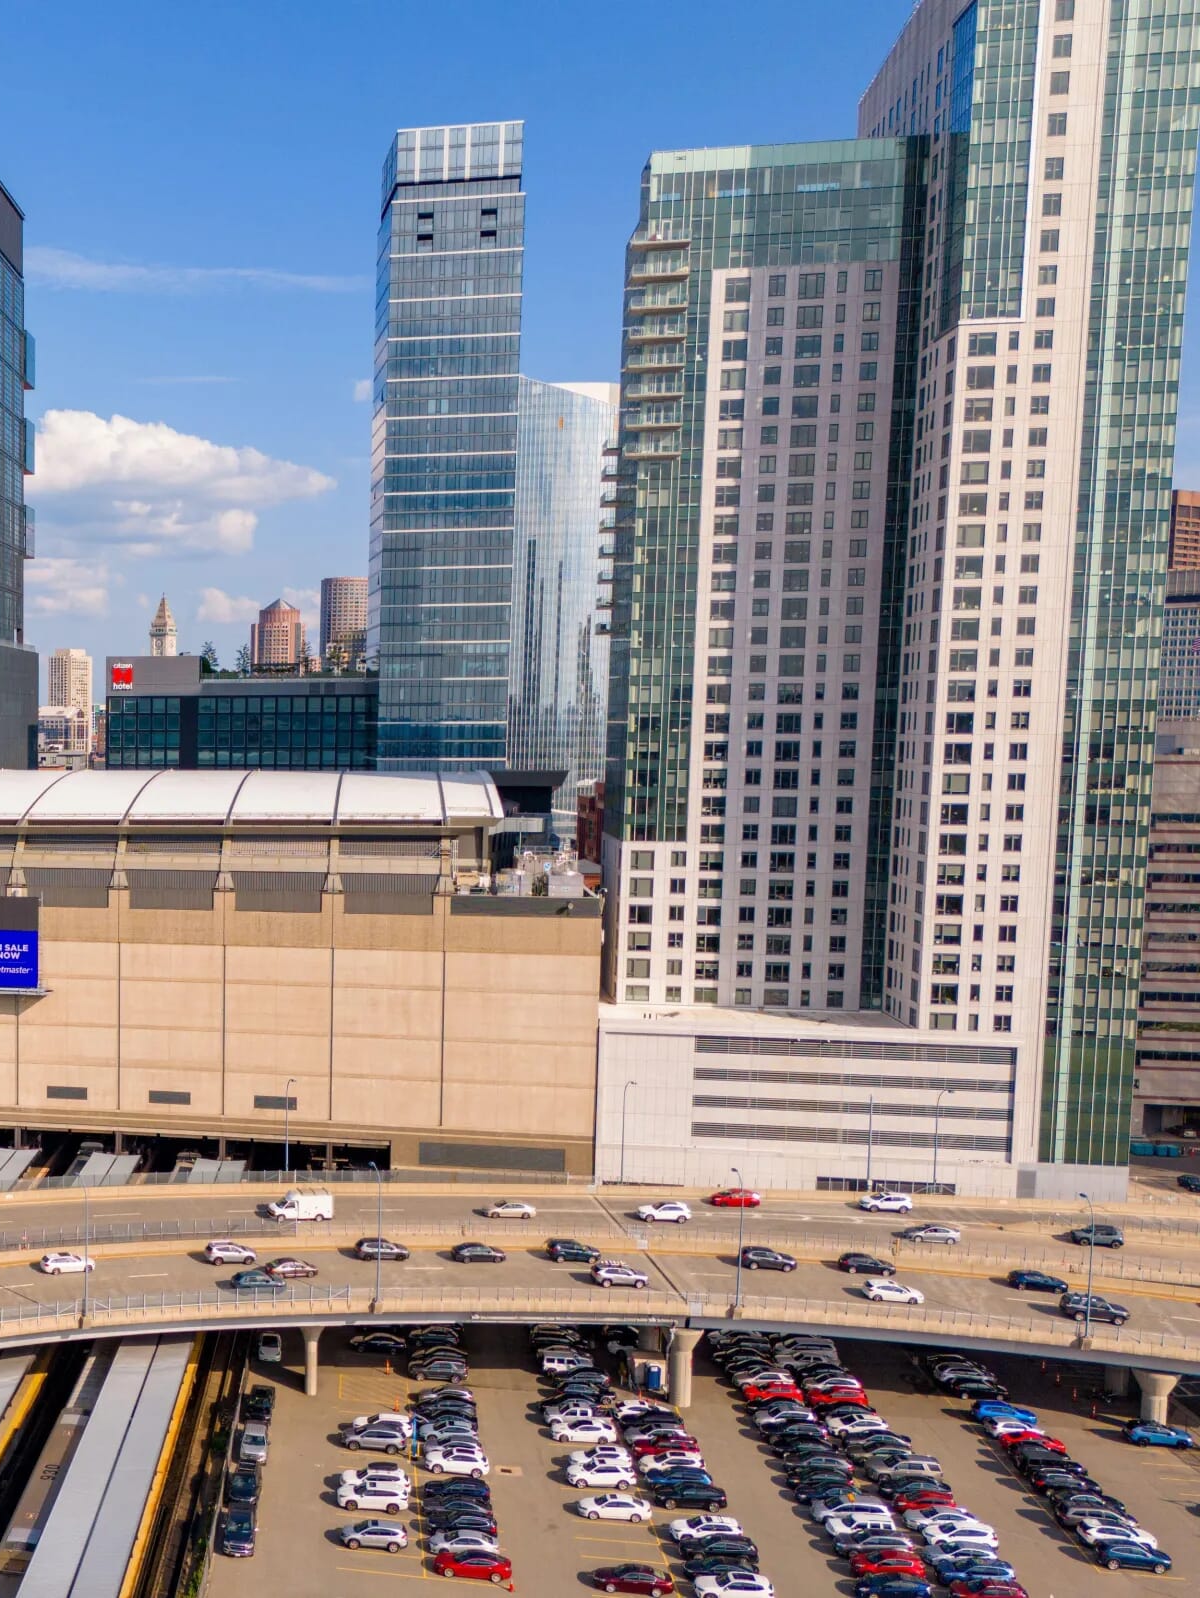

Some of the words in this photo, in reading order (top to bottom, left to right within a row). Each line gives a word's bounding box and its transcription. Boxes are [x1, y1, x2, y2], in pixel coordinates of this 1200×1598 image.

[112, 682, 133, 690] hotel
[4, 944, 29, 952] SALE
[40, 1464, 60, 1481] 930
